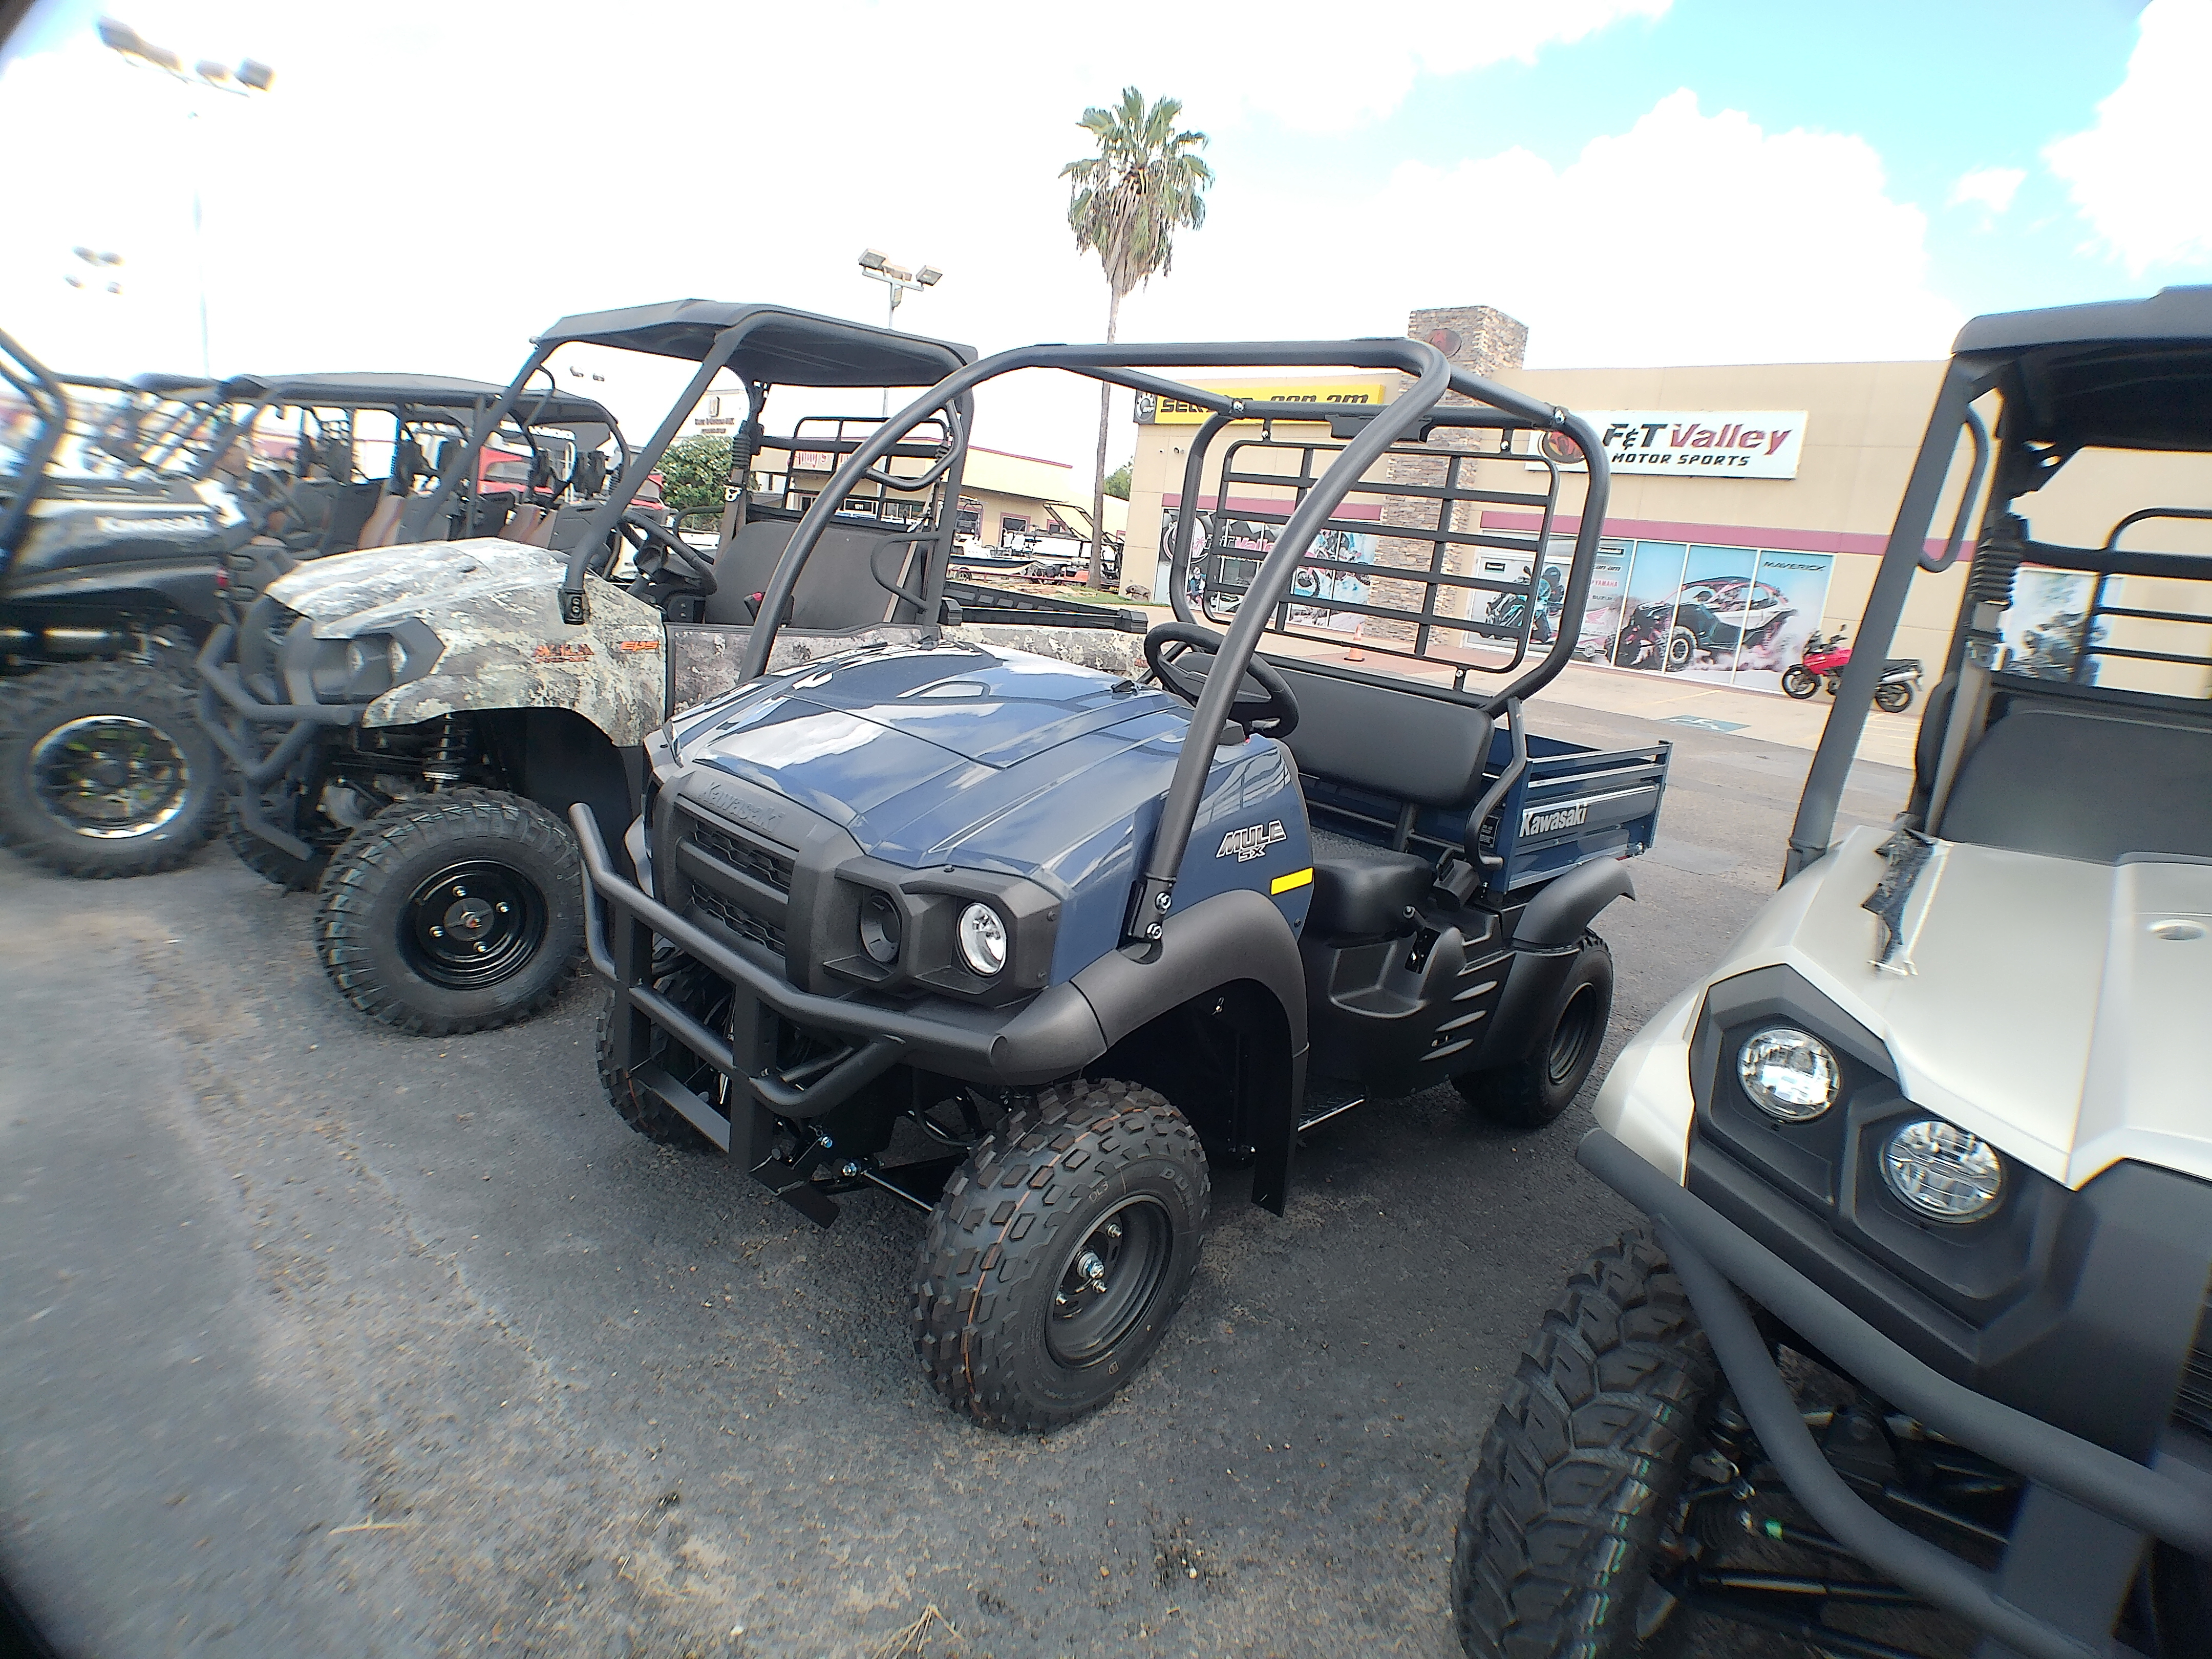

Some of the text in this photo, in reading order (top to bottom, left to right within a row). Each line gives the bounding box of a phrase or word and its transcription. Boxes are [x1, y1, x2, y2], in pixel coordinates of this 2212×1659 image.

[1602, 423, 1793, 455] F&T Valley
[1612, 453, 1751, 466] MOTOR SPORTS
[1763, 561, 1826, 571] MAVERICK
[699, 781, 785, 832] Kawasaki
[1519, 801, 1588, 838] Kawasaki
[1216, 819, 1288, 858] MULE
[1238, 845, 1266, 862] SX
